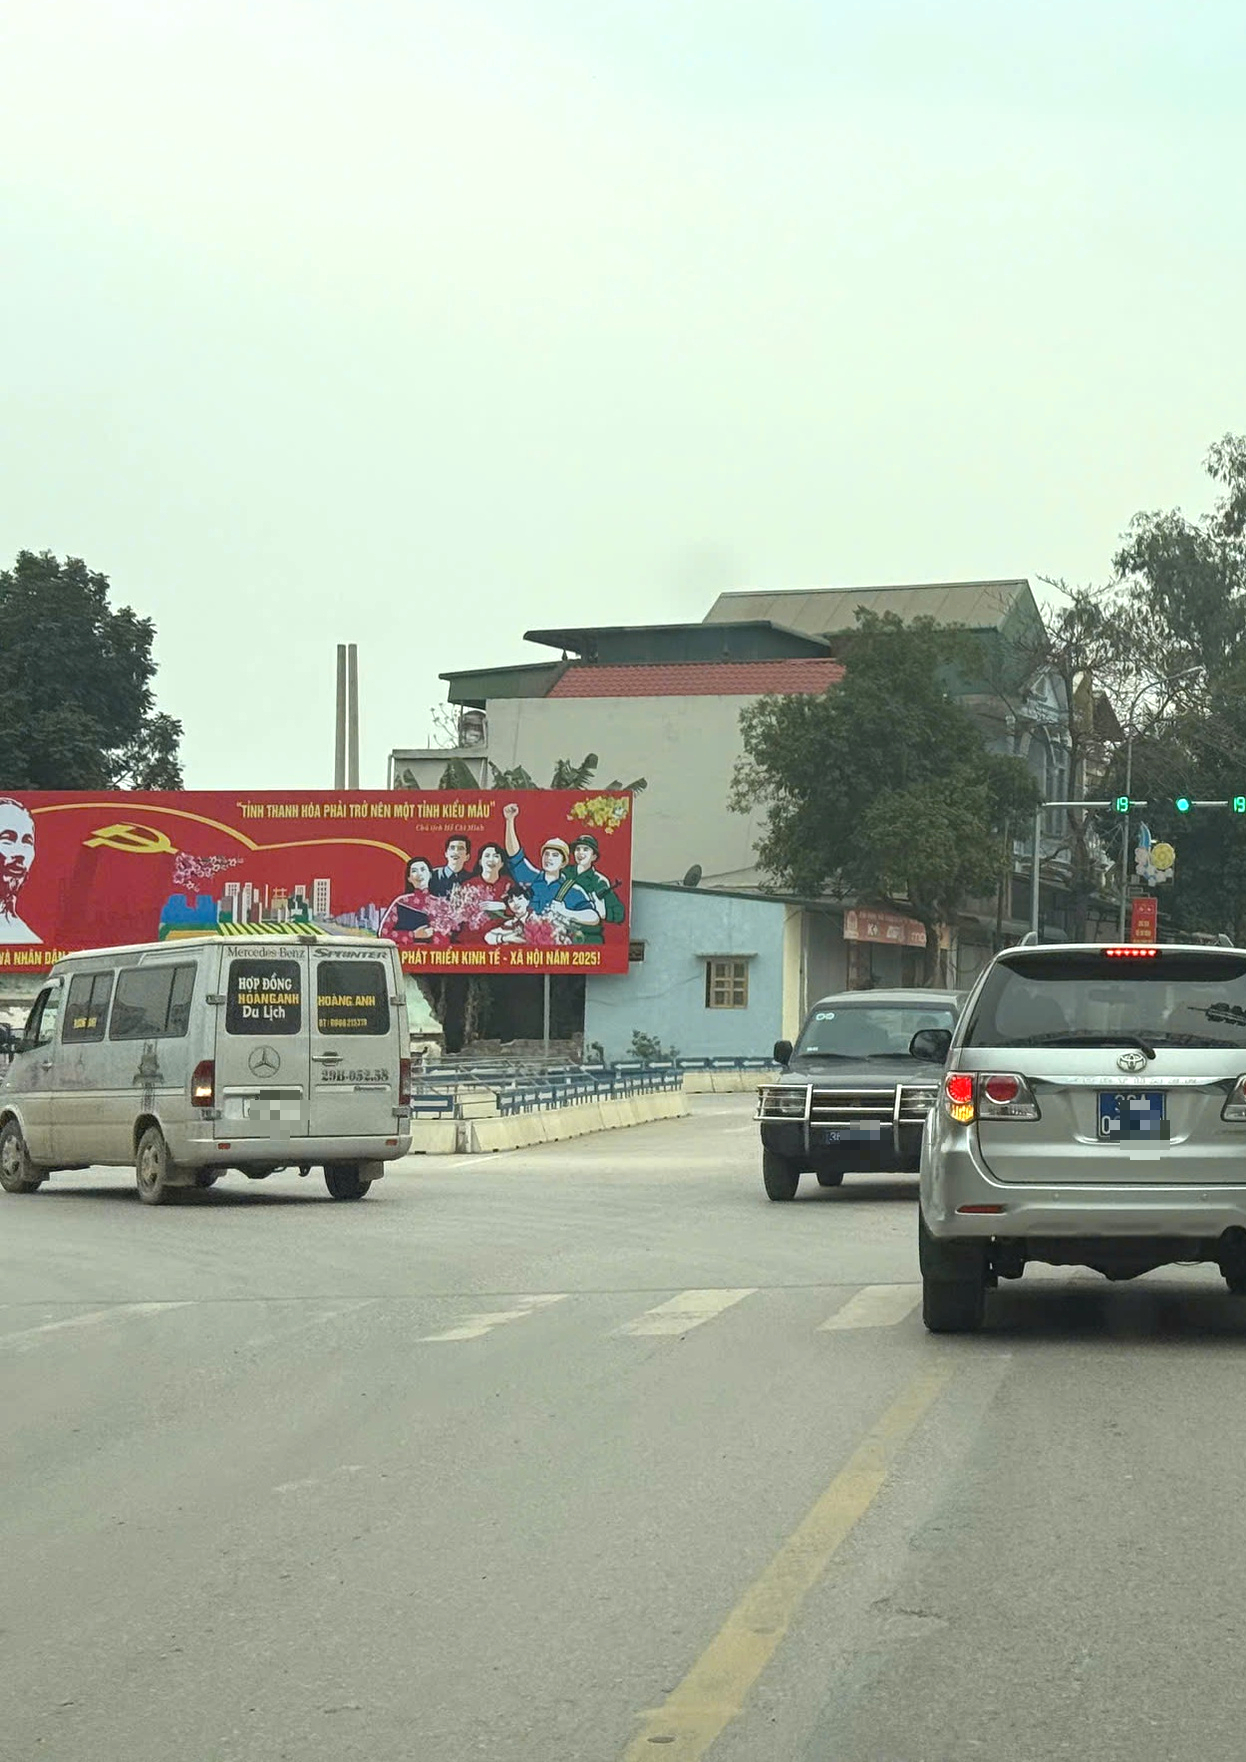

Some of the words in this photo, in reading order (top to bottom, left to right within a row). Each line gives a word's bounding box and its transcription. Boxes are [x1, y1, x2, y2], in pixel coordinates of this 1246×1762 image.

[267, 804, 299, 818] THANH
[301, 801, 320, 818] HÓA
[323, 800, 346, 818] PHẢI
[349, 800, 368, 818] TRỞ
[370, 801, 391, 818] NÊN
[394, 801, 415, 820] MỘT
[418, 800, 439, 818] TỈNH
[442, 798, 464, 818] KIỂU
[1116, 796, 1129, 812] 19
[1233, 796, 1246, 813] 19
[14, 949, 41, 965] NHÂN
[401, 948, 428, 965] PHÁT
[429, 946, 459, 965] TRIỂN
[461, 951, 486, 965] KINH
[488, 947, 500, 965] TẾ
[510, 949, 524, 965] XÃ
[527, 948, 543, 967] HỘI
[547, 949, 570, 965] NĂM
[572, 951, 601, 965] 2025!
[238, 976, 260, 992] HỢP
[262, 973, 292, 990] ĐỒNG
[242, 1006, 259, 1018] Du
[263, 1006, 286, 1021] Lịch
